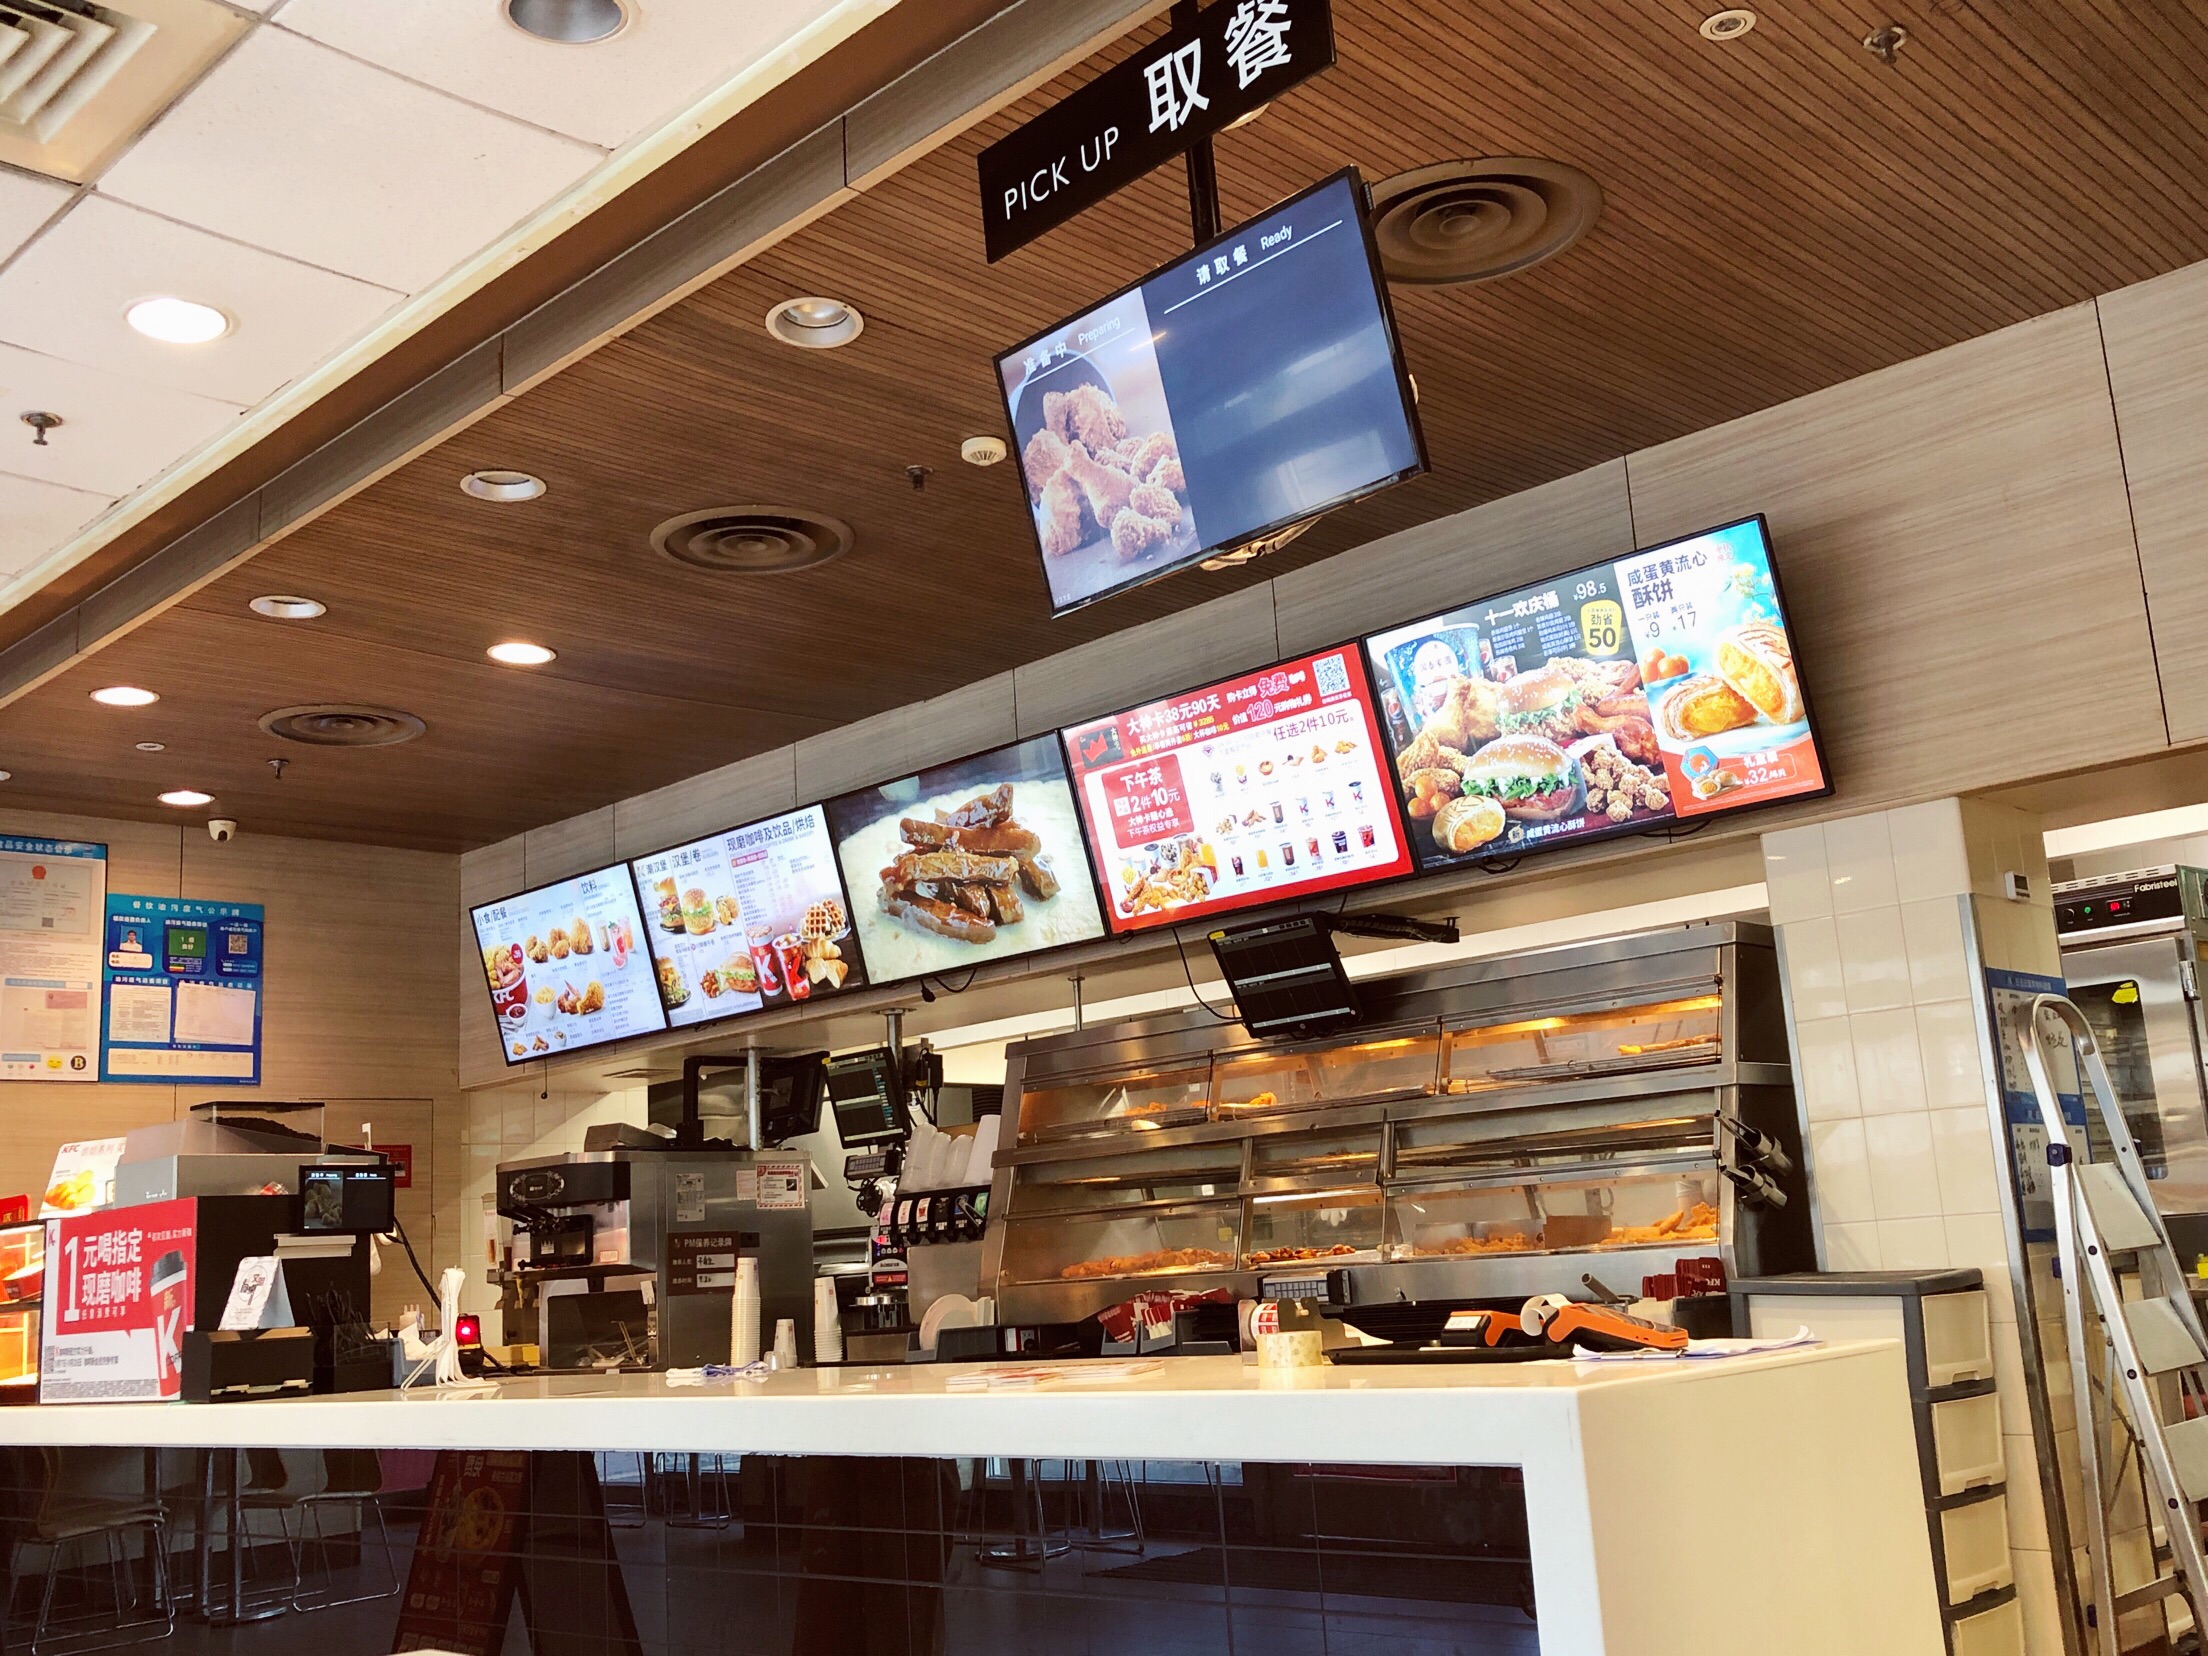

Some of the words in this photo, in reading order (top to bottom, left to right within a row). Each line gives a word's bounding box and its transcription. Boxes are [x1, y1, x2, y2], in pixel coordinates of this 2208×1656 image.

[1143, 0, 1293, 134] 取餐
[1004, 155, 1070, 220] PICK
[1079, 126, 1120, 173] UP
[1196, 243, 1249, 286] 请取餐
[1260, 223, 1293, 251] Ready
[1023, 341, 1068, 376] 准备中
[1077, 316, 1121, 346] Preparing
[1627, 550, 1708, 587] 咸蛋黄流心
[1484, 590, 1560, 627] 十一欢庆桶
[1631, 578, 1674, 609] 酥饼
[1588, 627, 1617, 648] 50
[1591, 612, 1614, 626] 劲省
[1127, 693, 1222, 736] 大神卡38元90天
[1119, 766, 1164, 793] 下午茶
[1130, 787, 1181, 812] 2件10元
[726, 814, 816, 852] 现磨咖啡及饮品/烘焙
[1526, 817, 1586, 839] 咸蛋黄流心酥饼
[581, 879, 598, 894] 饮料
[2134, 878, 2178, 893] Fabristeel
[61, 1144, 80, 1154] KFC
[63, 1235, 80, 1323] 1
[82, 1227, 143, 1269] 元喝指定
[81, 1266, 143, 1306] 现磨咖啡
